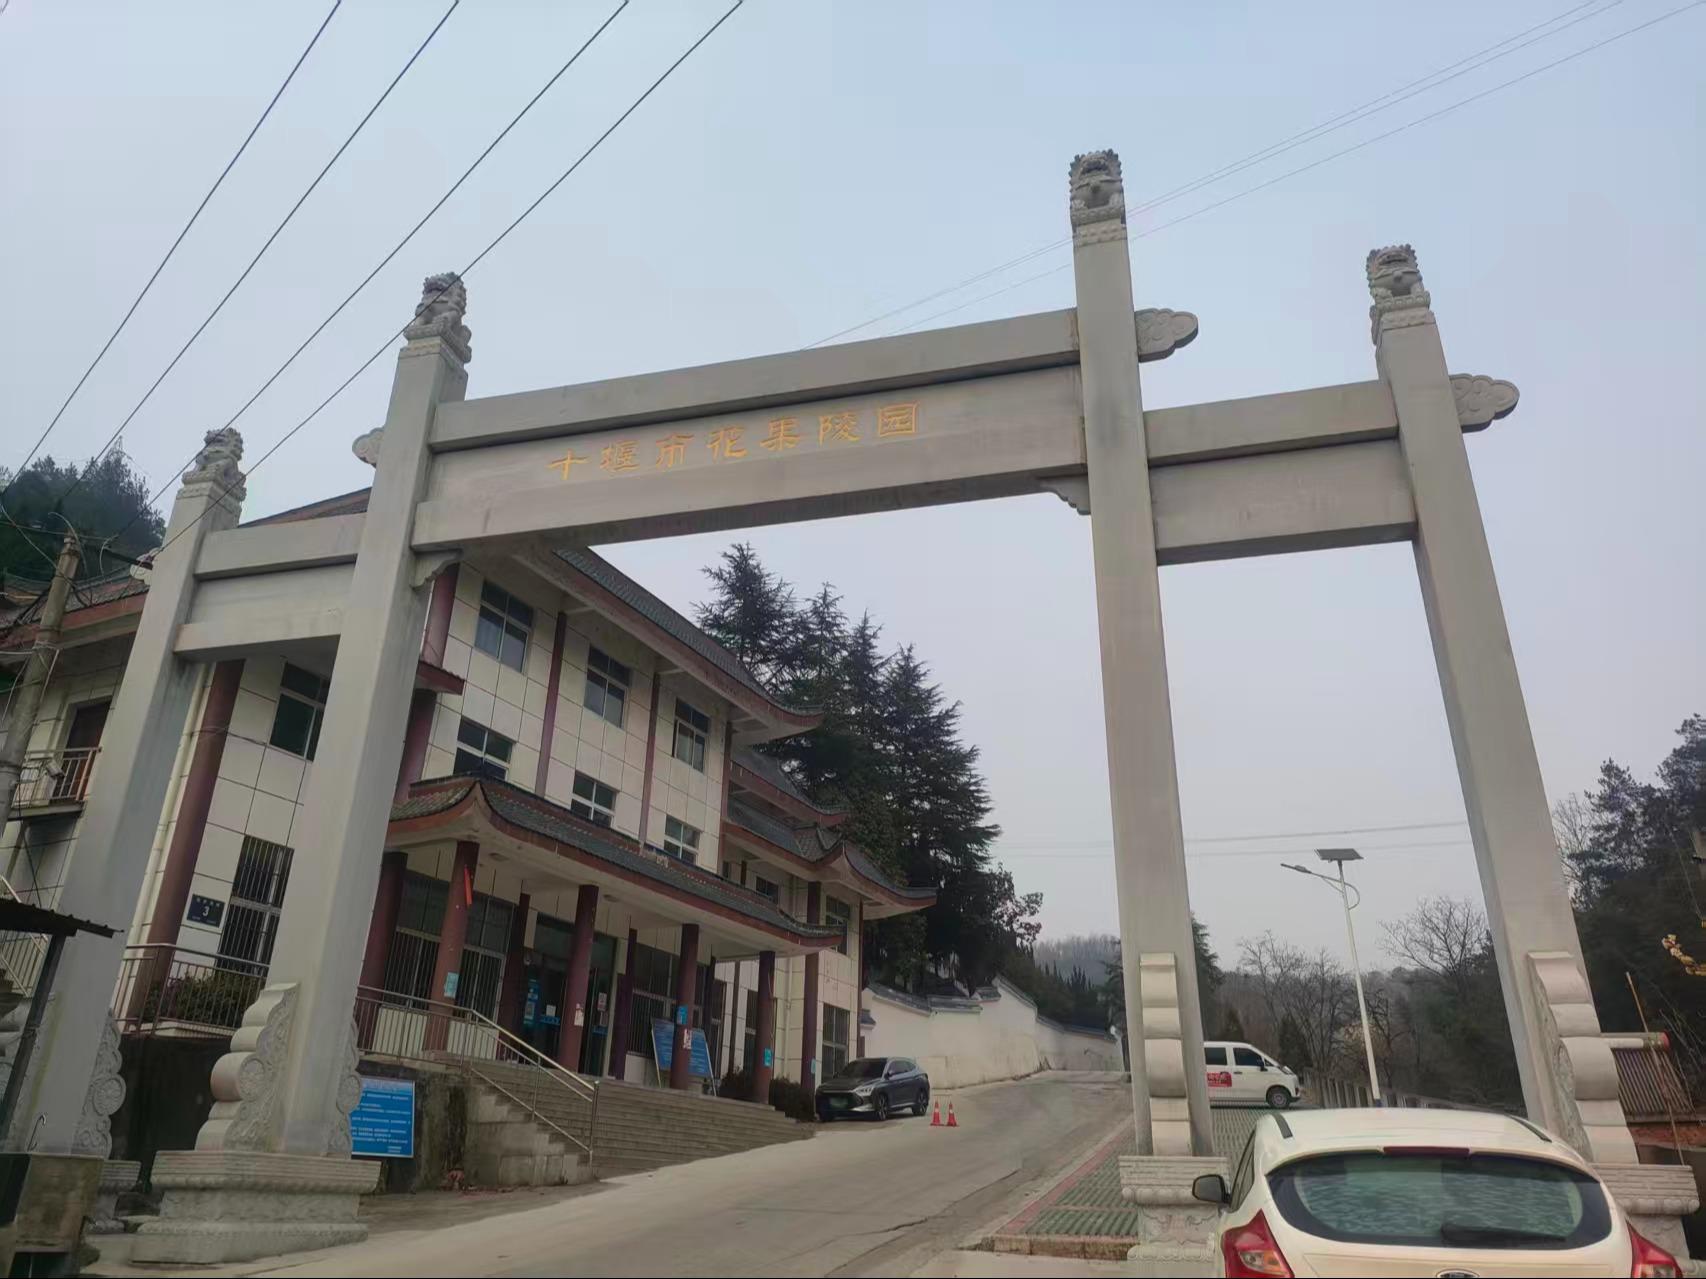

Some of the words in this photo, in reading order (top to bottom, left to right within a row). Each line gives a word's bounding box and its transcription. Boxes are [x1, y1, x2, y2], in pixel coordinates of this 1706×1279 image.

[546, 401, 920, 480] 十堰市花果陵园
[202, 905, 210, 917] 3
